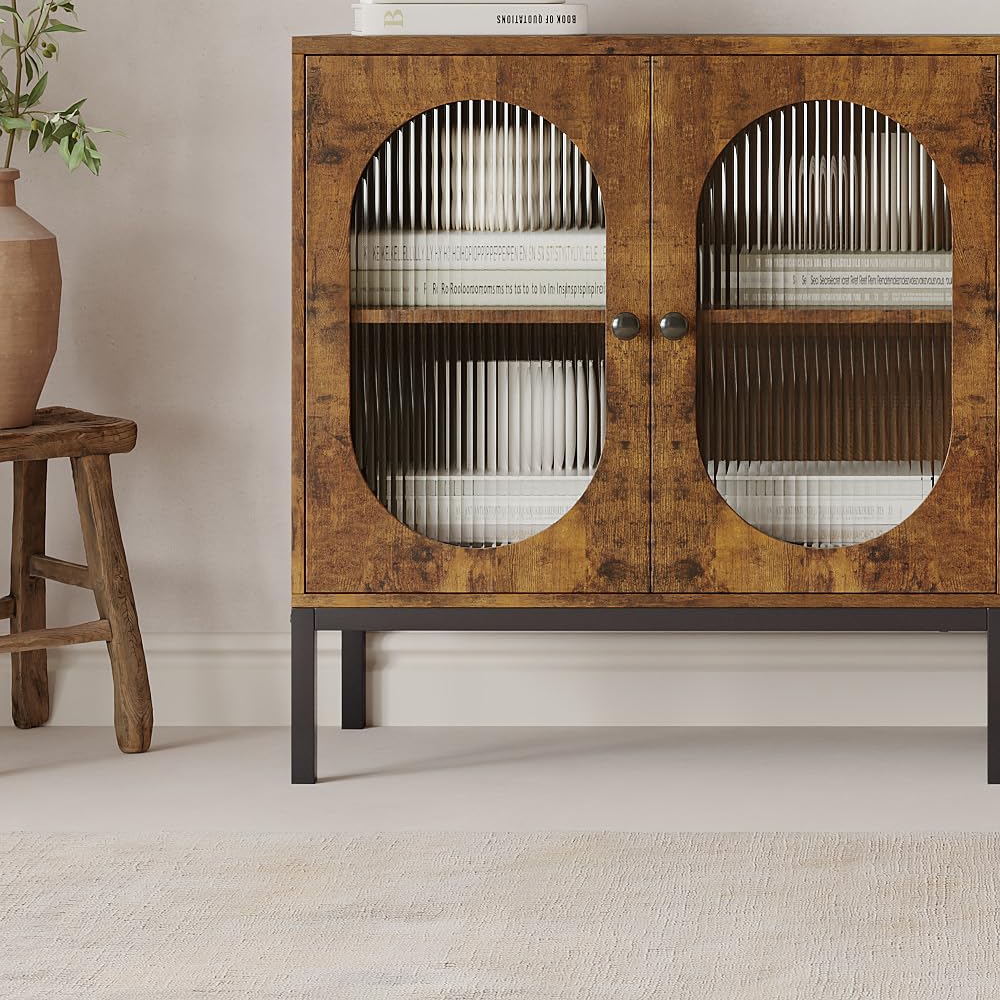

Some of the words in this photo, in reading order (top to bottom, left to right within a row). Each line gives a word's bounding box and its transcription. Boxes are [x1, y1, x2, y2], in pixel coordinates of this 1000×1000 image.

[496, 13, 543, 24] QUOTATIONS
[545, 14, 554, 24] OF
[556, 14, 577, 24] BOOK
